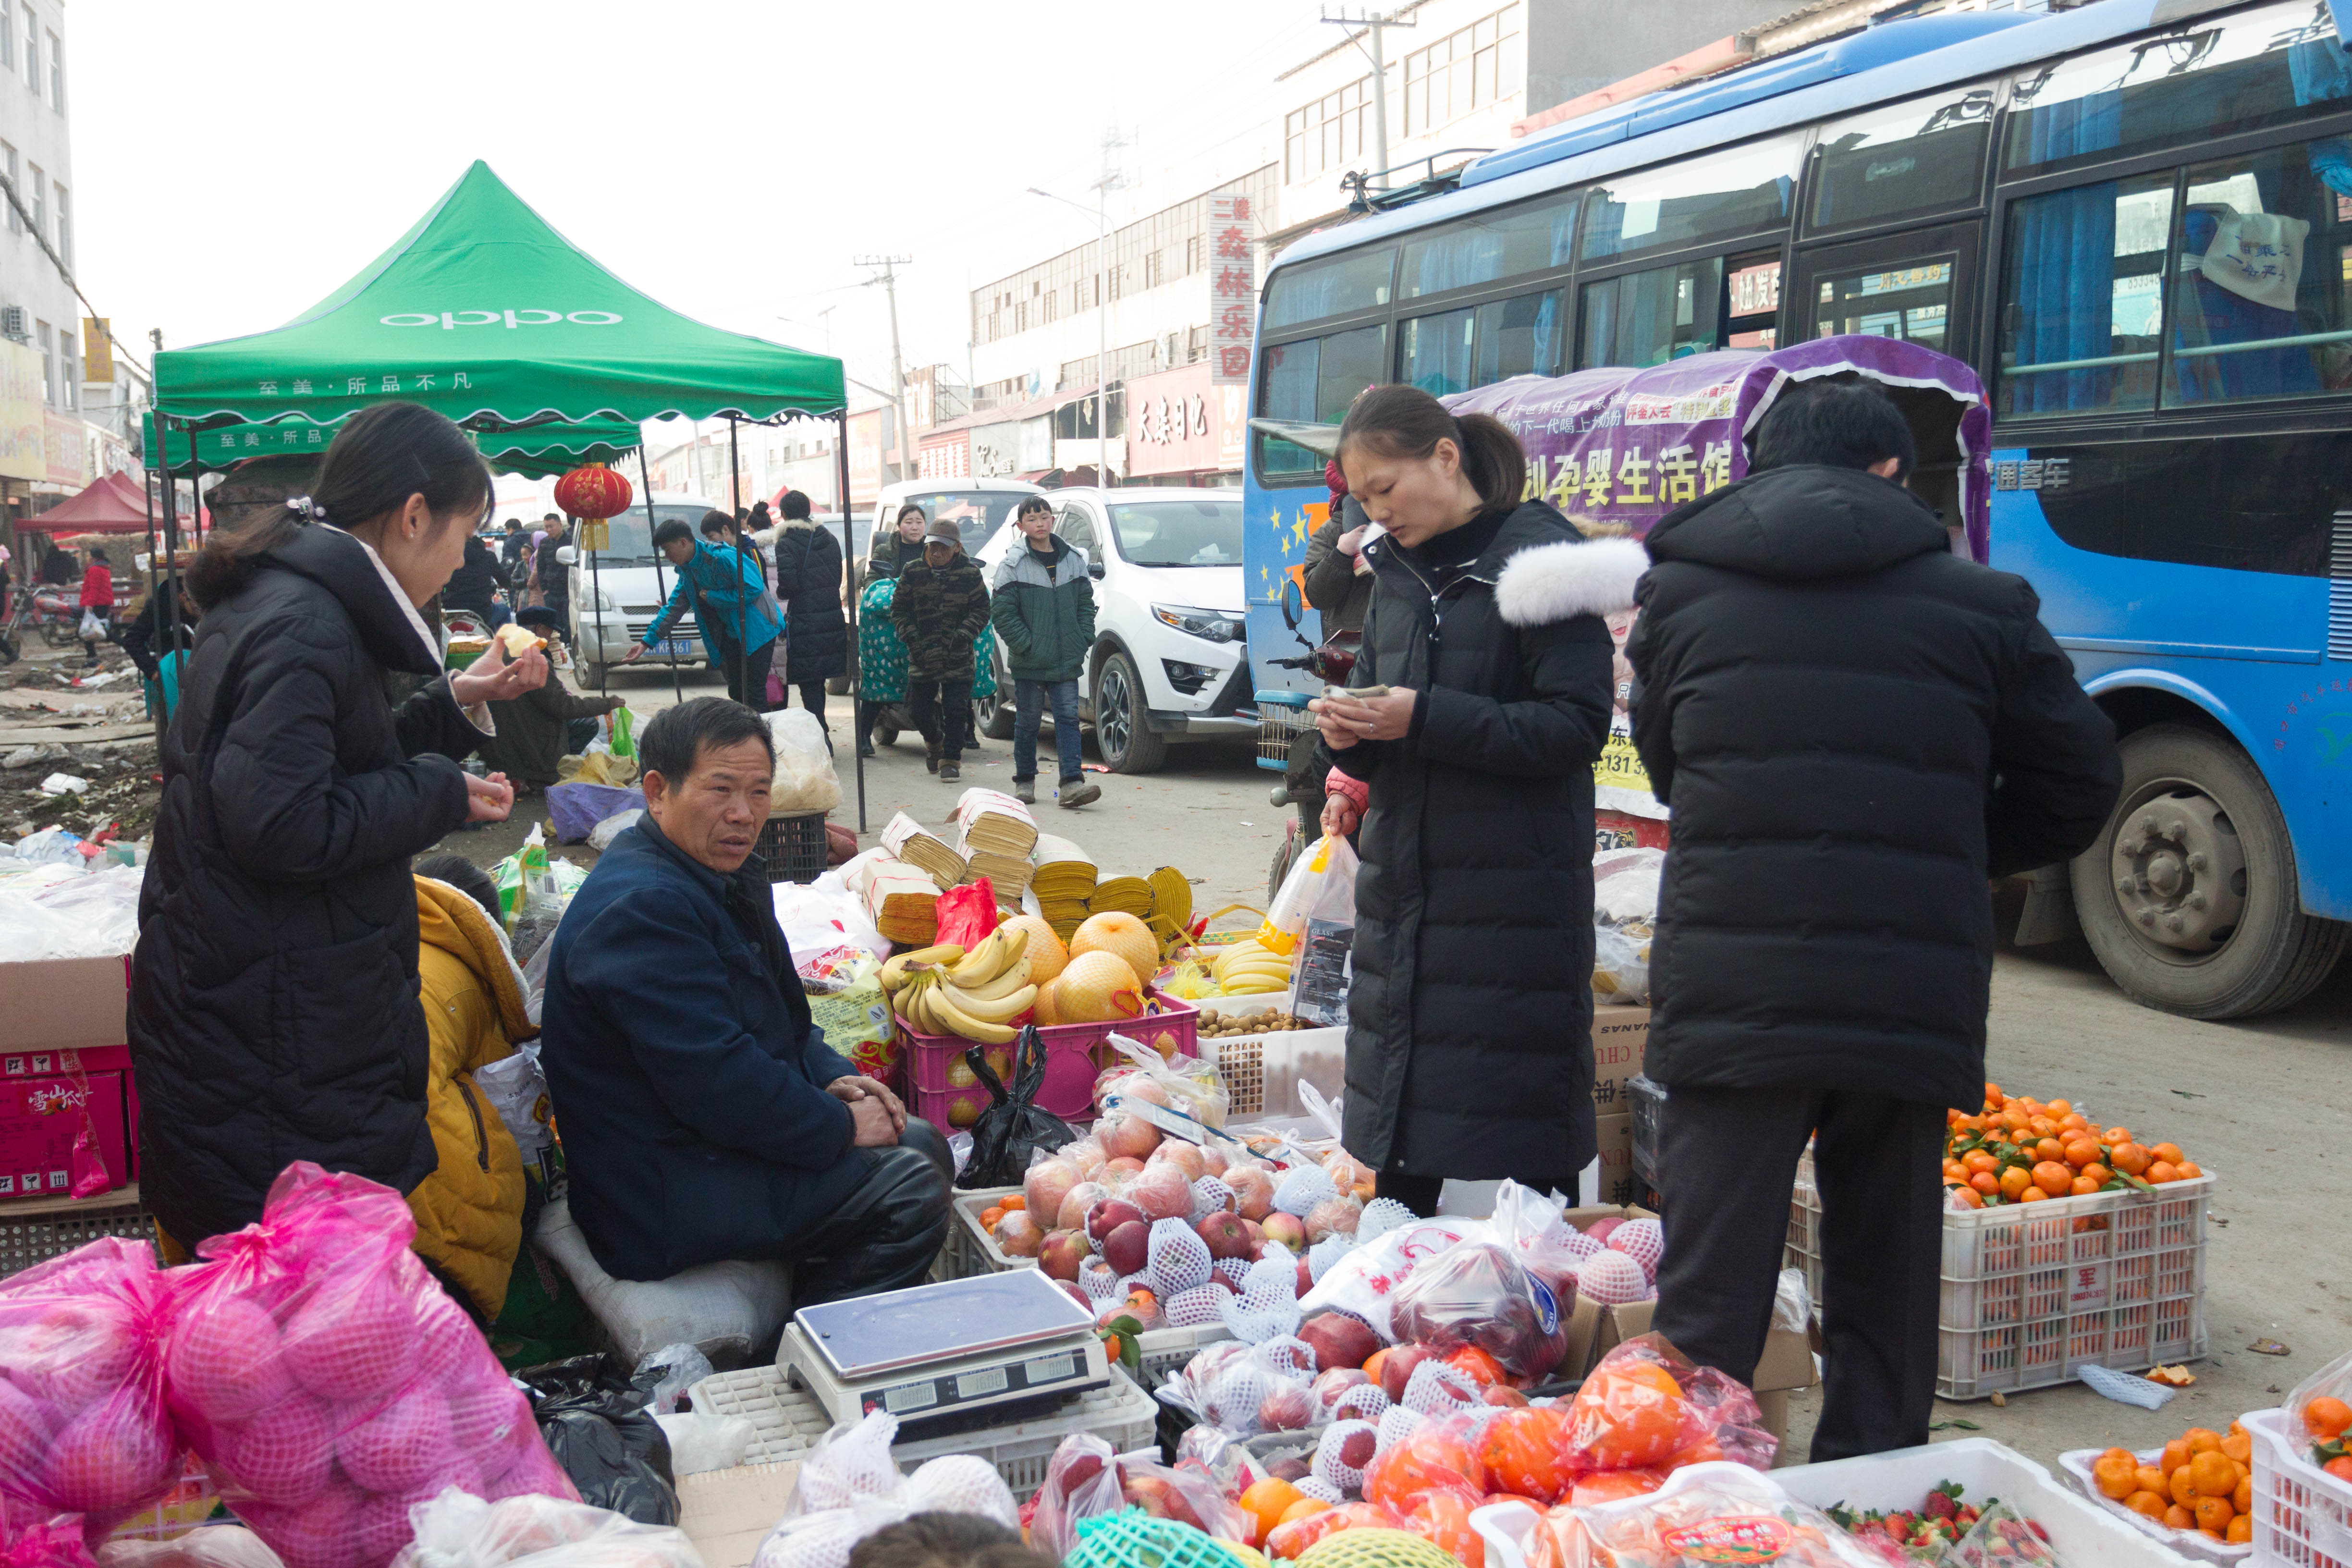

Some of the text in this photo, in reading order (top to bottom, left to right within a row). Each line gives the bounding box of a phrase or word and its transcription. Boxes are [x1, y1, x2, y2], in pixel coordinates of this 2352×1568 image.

[1214, 196, 1250, 220] 二楼
[1215, 225, 1252, 377] 森林乐园
[1990, 458, 2070, 491] 通客车
[1311, 928, 1334, 937] GLASS
[2078, 1267, 2096, 1289] 军
